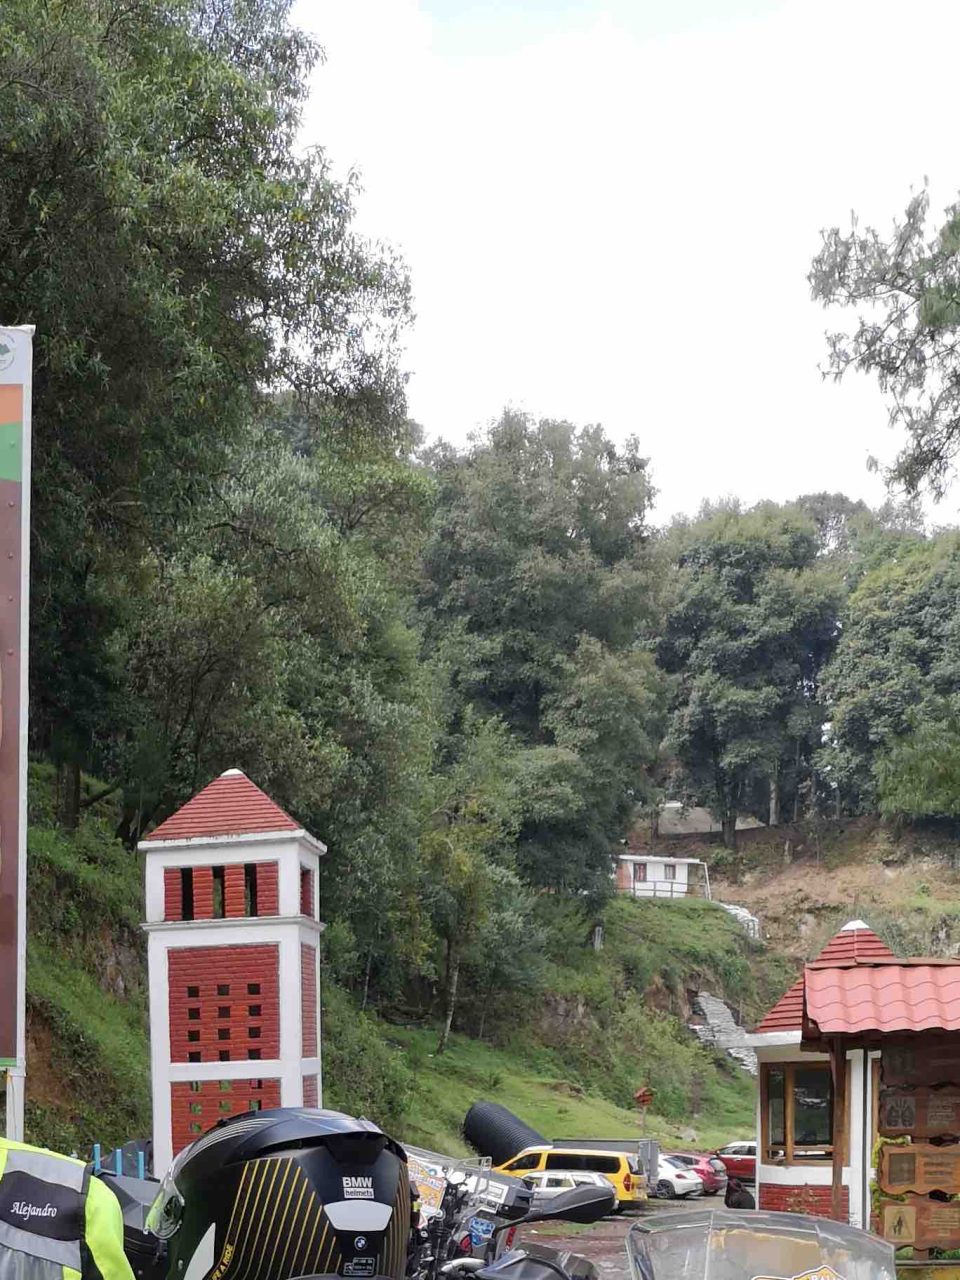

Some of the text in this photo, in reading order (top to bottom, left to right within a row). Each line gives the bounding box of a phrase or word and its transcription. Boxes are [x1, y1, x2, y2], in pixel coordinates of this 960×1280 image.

[342, 1177, 373, 1188] BMW
[344, 1189, 373, 1197] helmets
[10, 1201, 58, 1219] Alejandro
